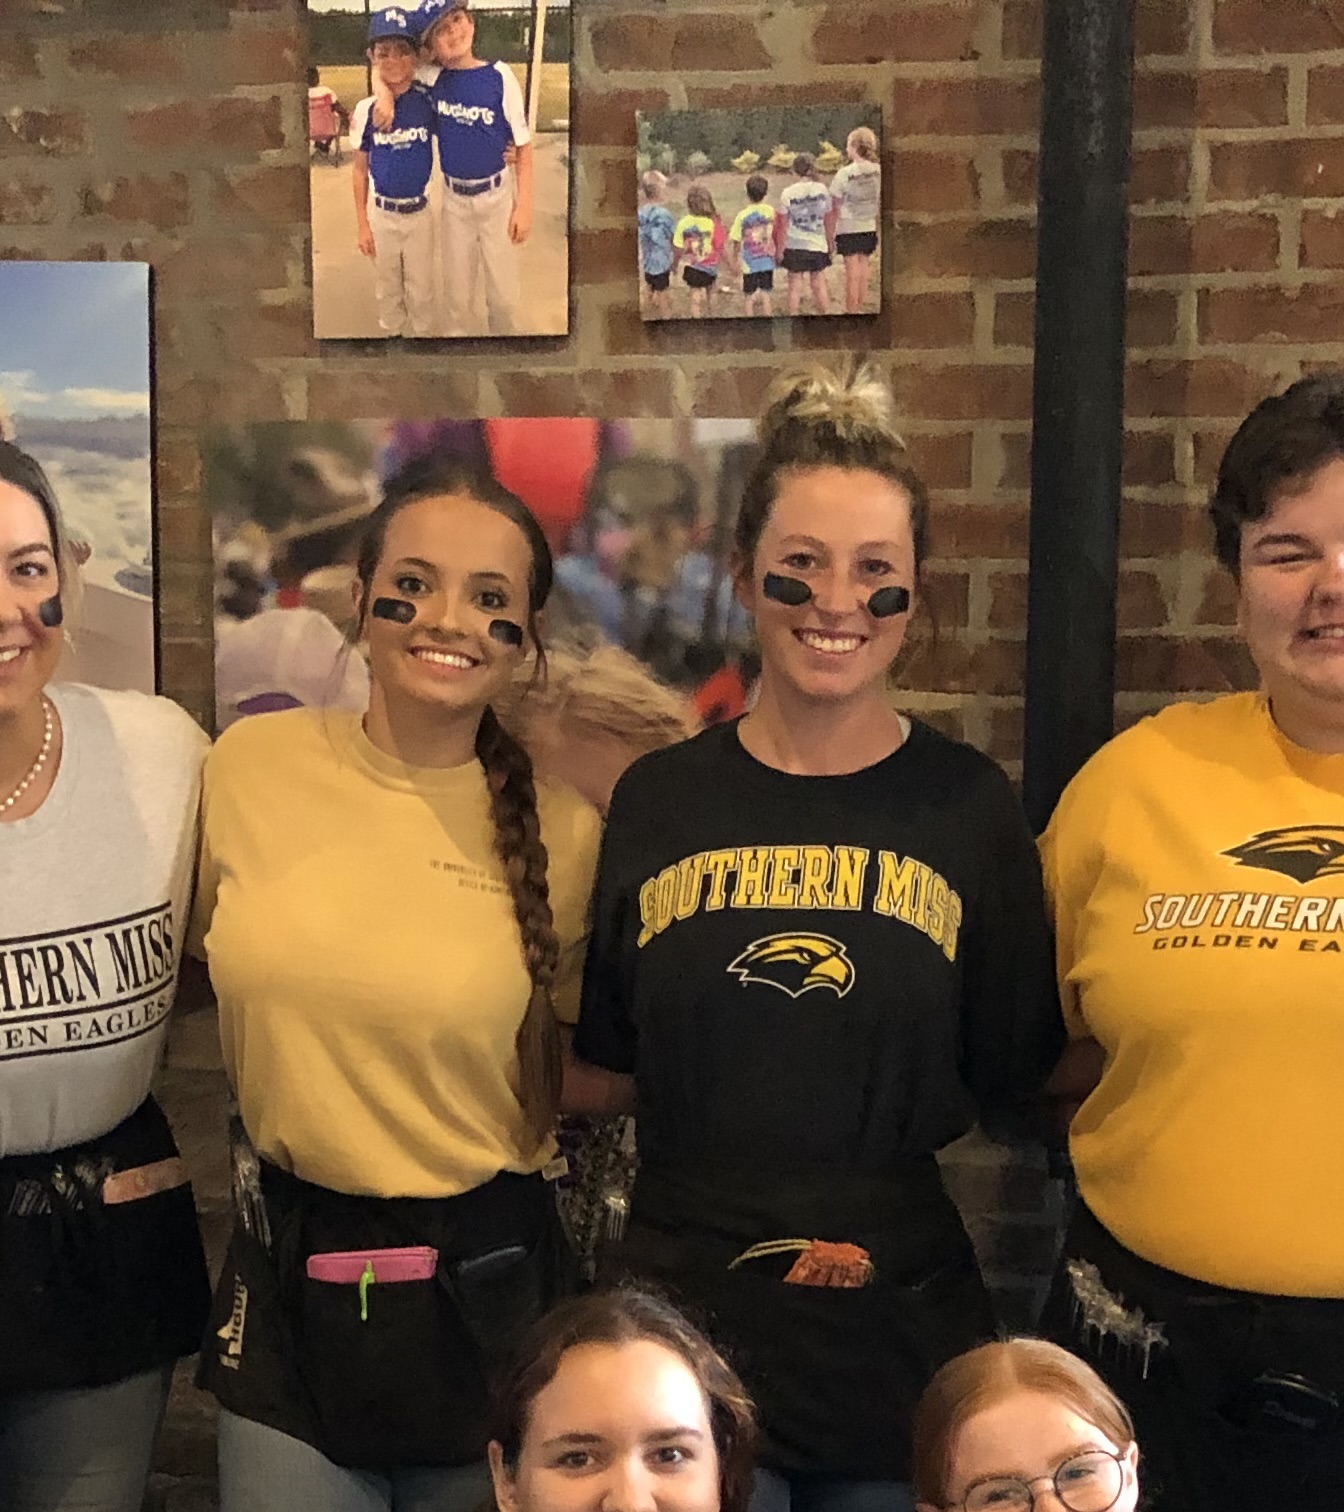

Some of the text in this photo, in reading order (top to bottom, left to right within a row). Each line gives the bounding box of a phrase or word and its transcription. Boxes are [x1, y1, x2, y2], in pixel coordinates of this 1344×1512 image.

[637, 845, 963, 963] SOUTHERN MISS
[105, 911, 175, 994] MISS
[1152, 934, 1280, 951] GOLDEN
[64, 996, 166, 1042] EAGLES
